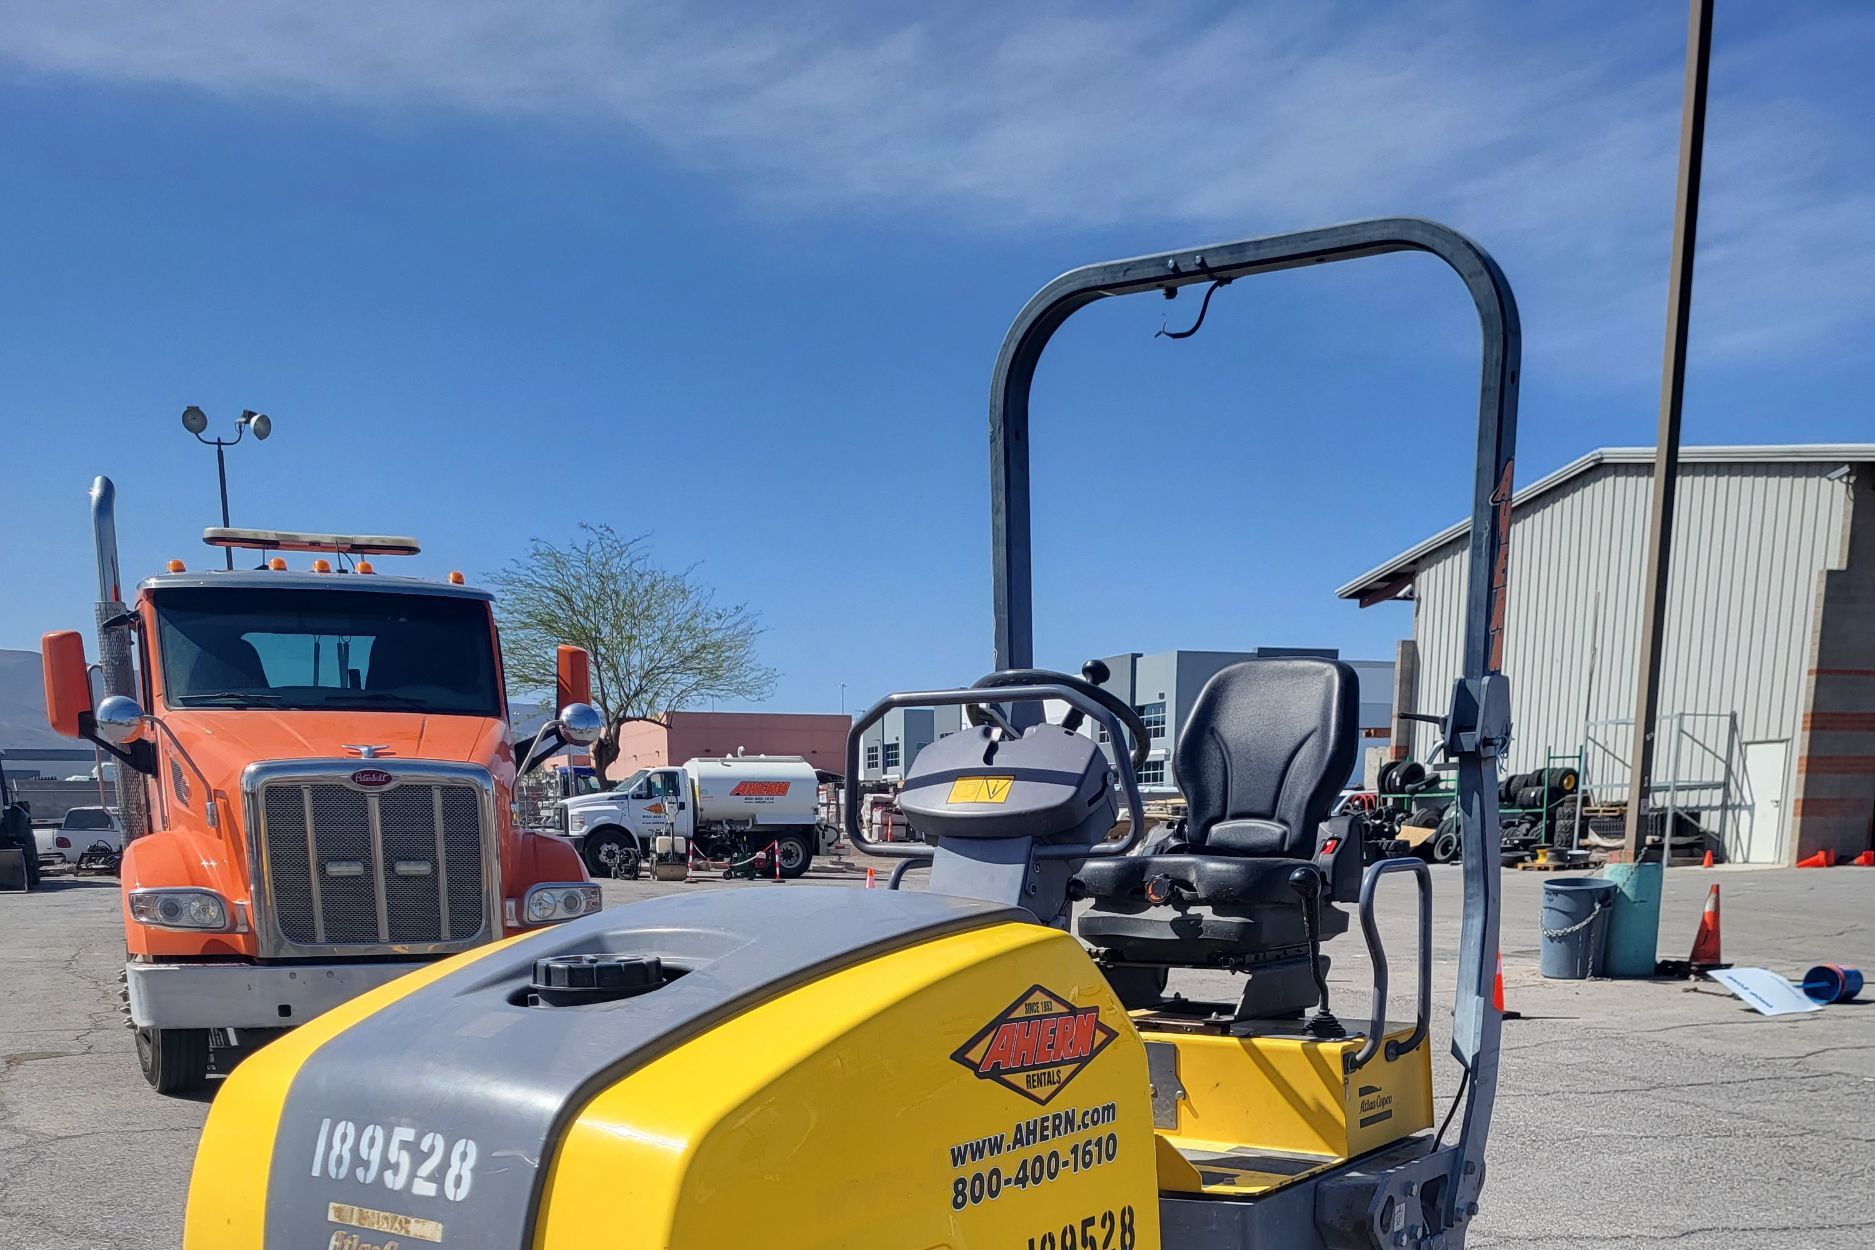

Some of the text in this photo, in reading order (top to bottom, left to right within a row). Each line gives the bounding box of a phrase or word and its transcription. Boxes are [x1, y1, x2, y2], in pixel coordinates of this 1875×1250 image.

[728, 780, 791, 796] AHERN
[1025, 1002, 1040, 1014] SINCE
[979, 1013, 1098, 1072] AHERN
[1025, 1069, 1062, 1089] RENTALS
[311, 1118, 477, 1201] 189528
[950, 1101, 1117, 1168] www.AHERN.com
[952, 1132, 1118, 1211] 800-400-1610
